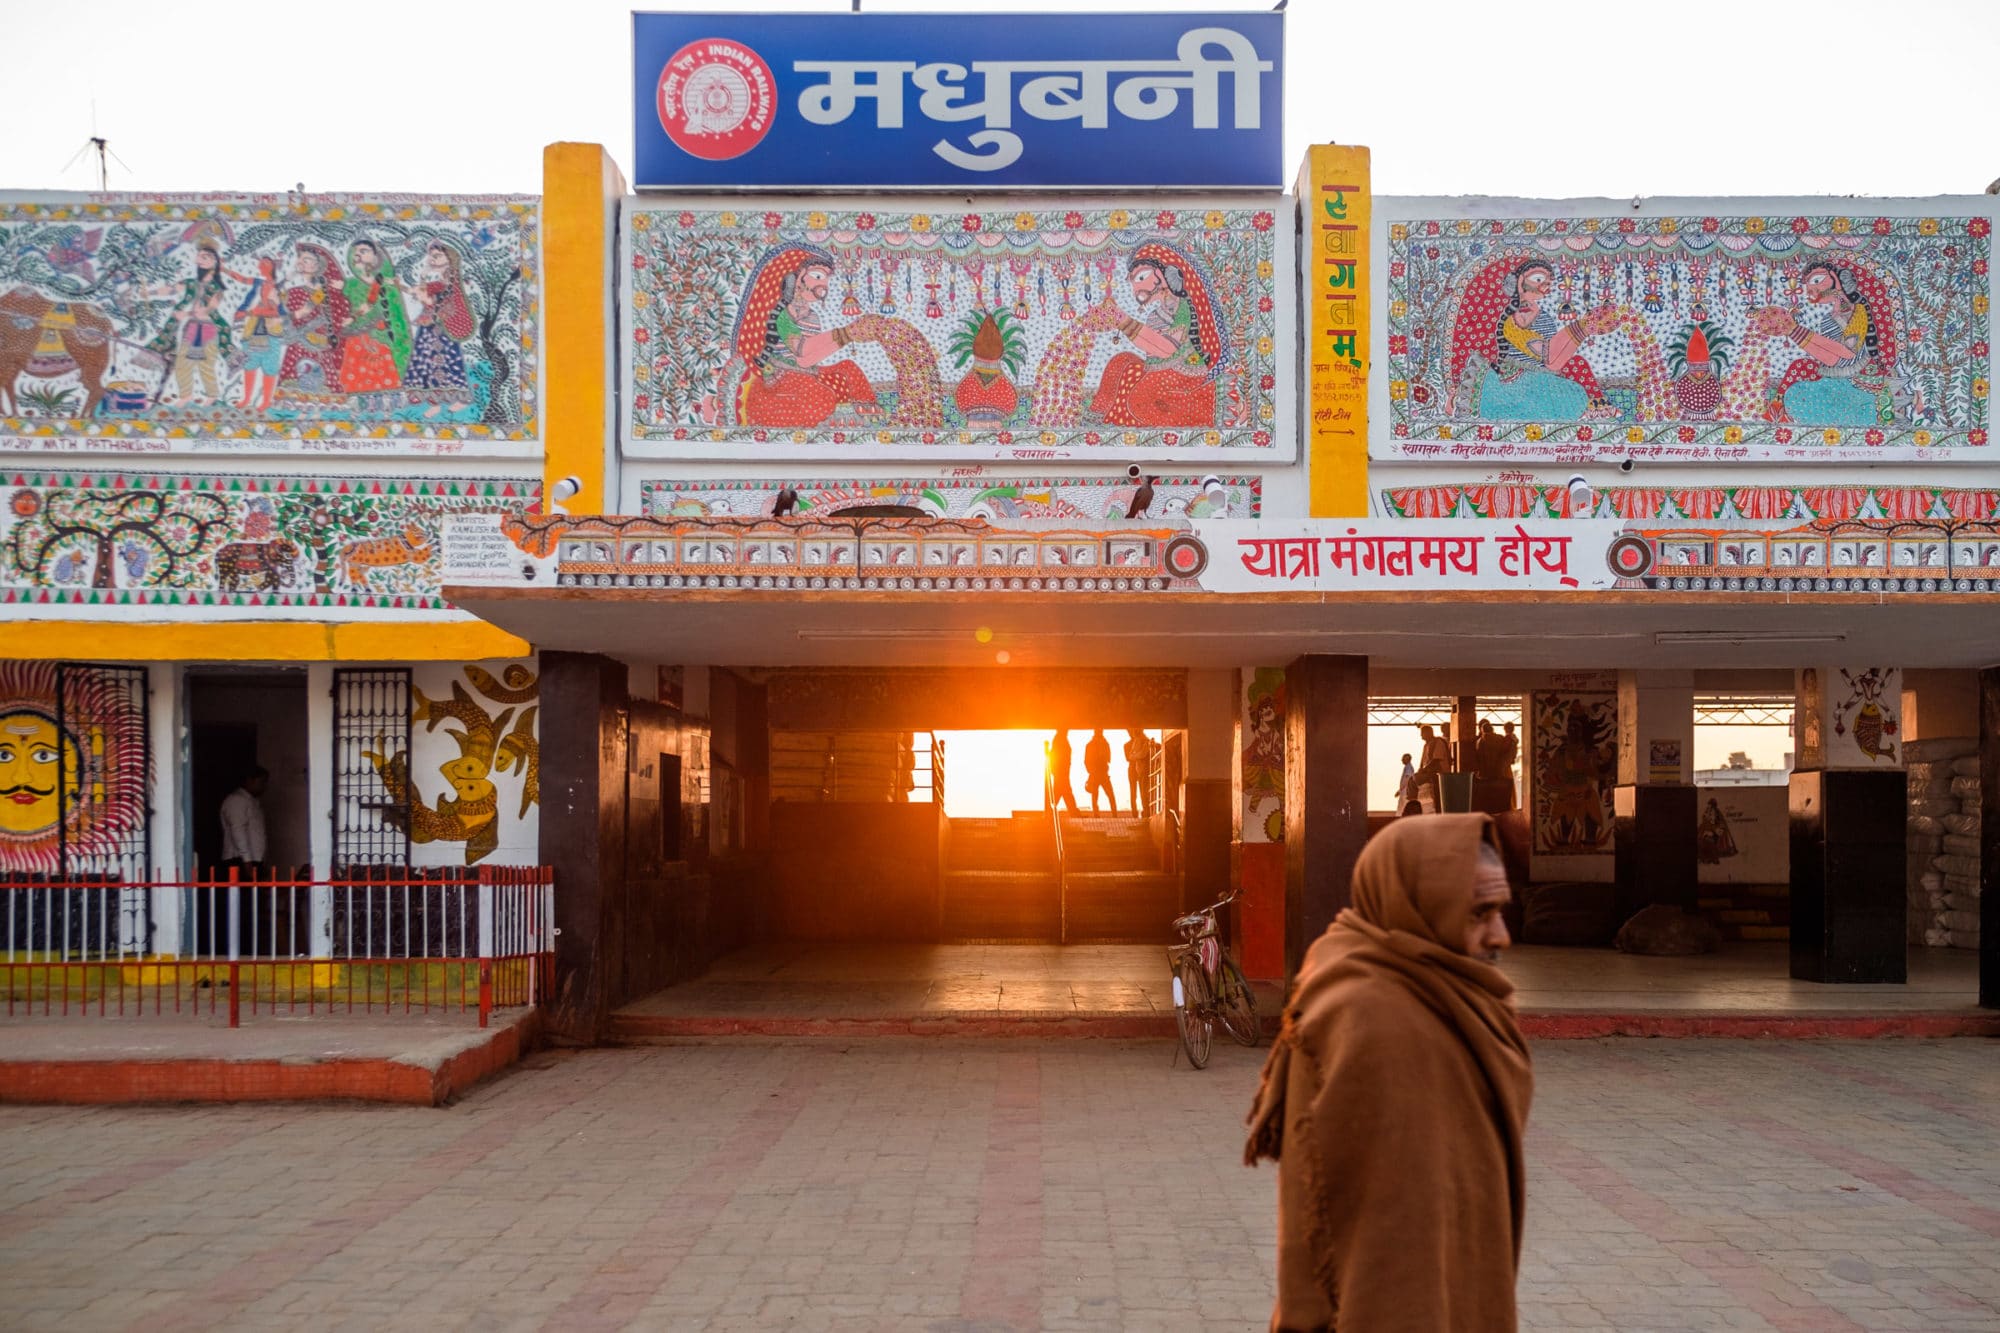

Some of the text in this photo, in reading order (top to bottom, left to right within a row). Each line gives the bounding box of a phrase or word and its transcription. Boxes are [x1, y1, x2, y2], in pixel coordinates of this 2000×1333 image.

[708, 45, 771, 131] INDIAN RAILWAYS
[793, 27, 1274, 172] मधुबनी
[288, 193, 337, 205] KMARI
[43, 438, 77, 449] NATH
[1238, 536, 1321, 581] यात्रा
[1325, 527, 1485, 577] मंगलमय
